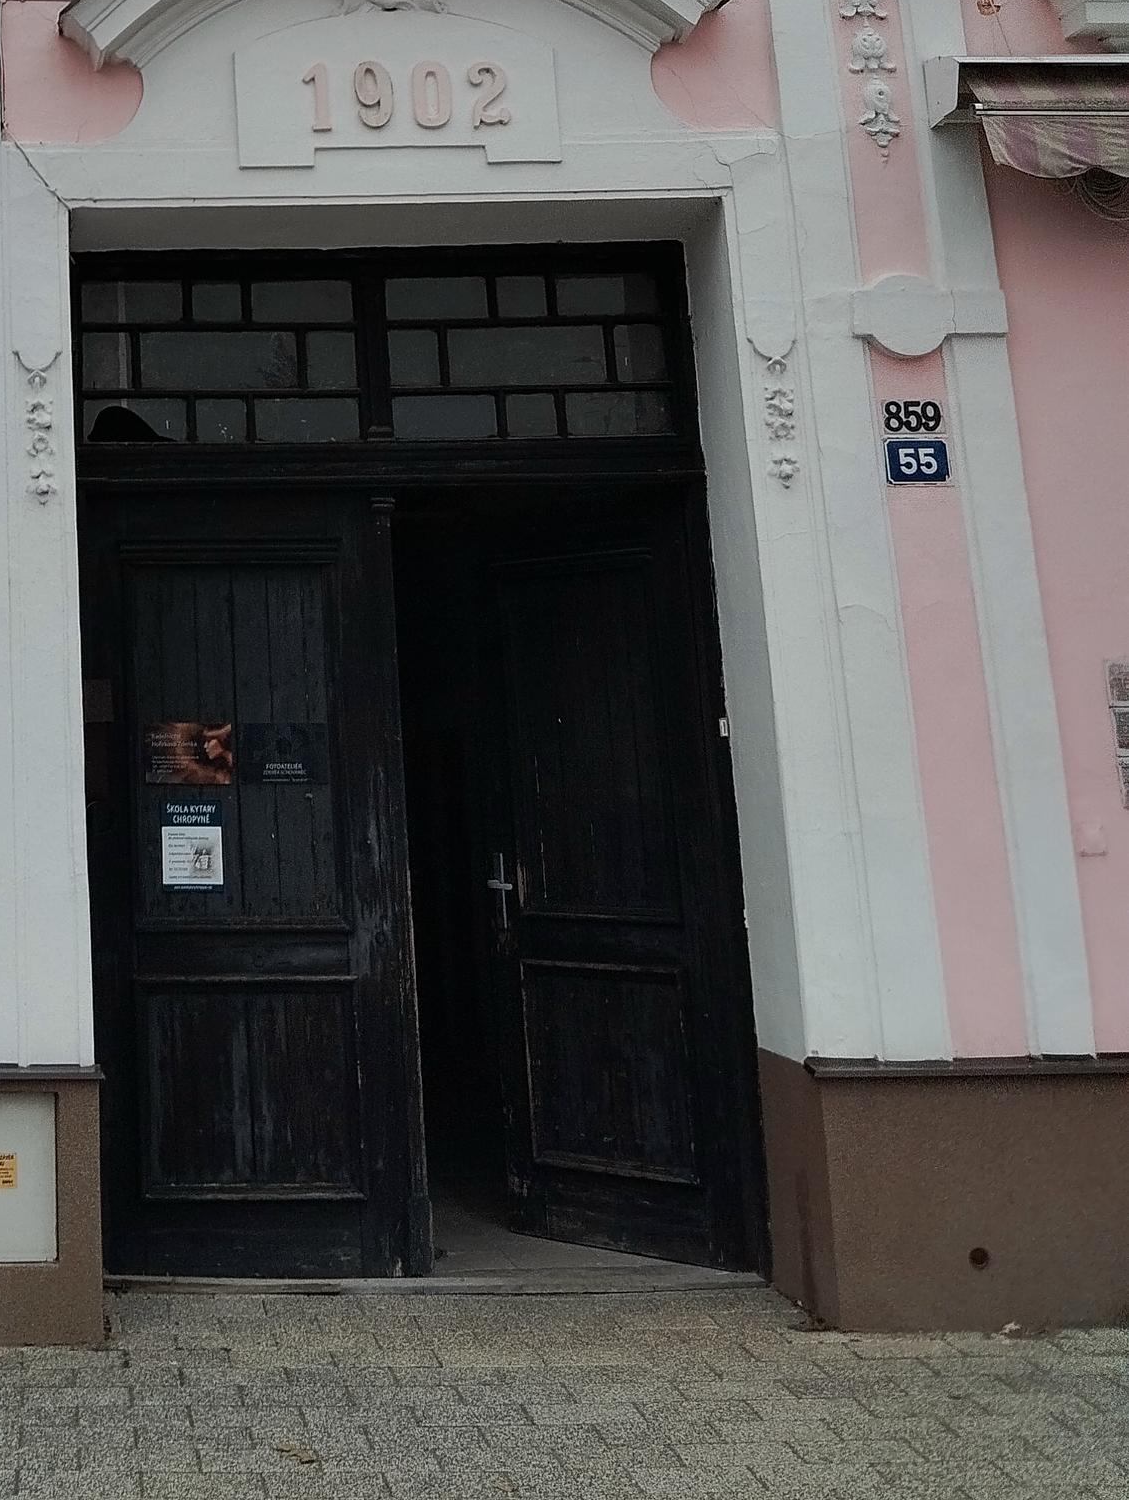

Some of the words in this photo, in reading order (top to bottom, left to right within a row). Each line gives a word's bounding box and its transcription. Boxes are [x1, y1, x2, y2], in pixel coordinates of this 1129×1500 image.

[301, 60, 511, 133] 1902
[883, 400, 942, 432] 859
[898, 447, 938, 475] 55
[166, 802, 189, 813] ŠKOLA
